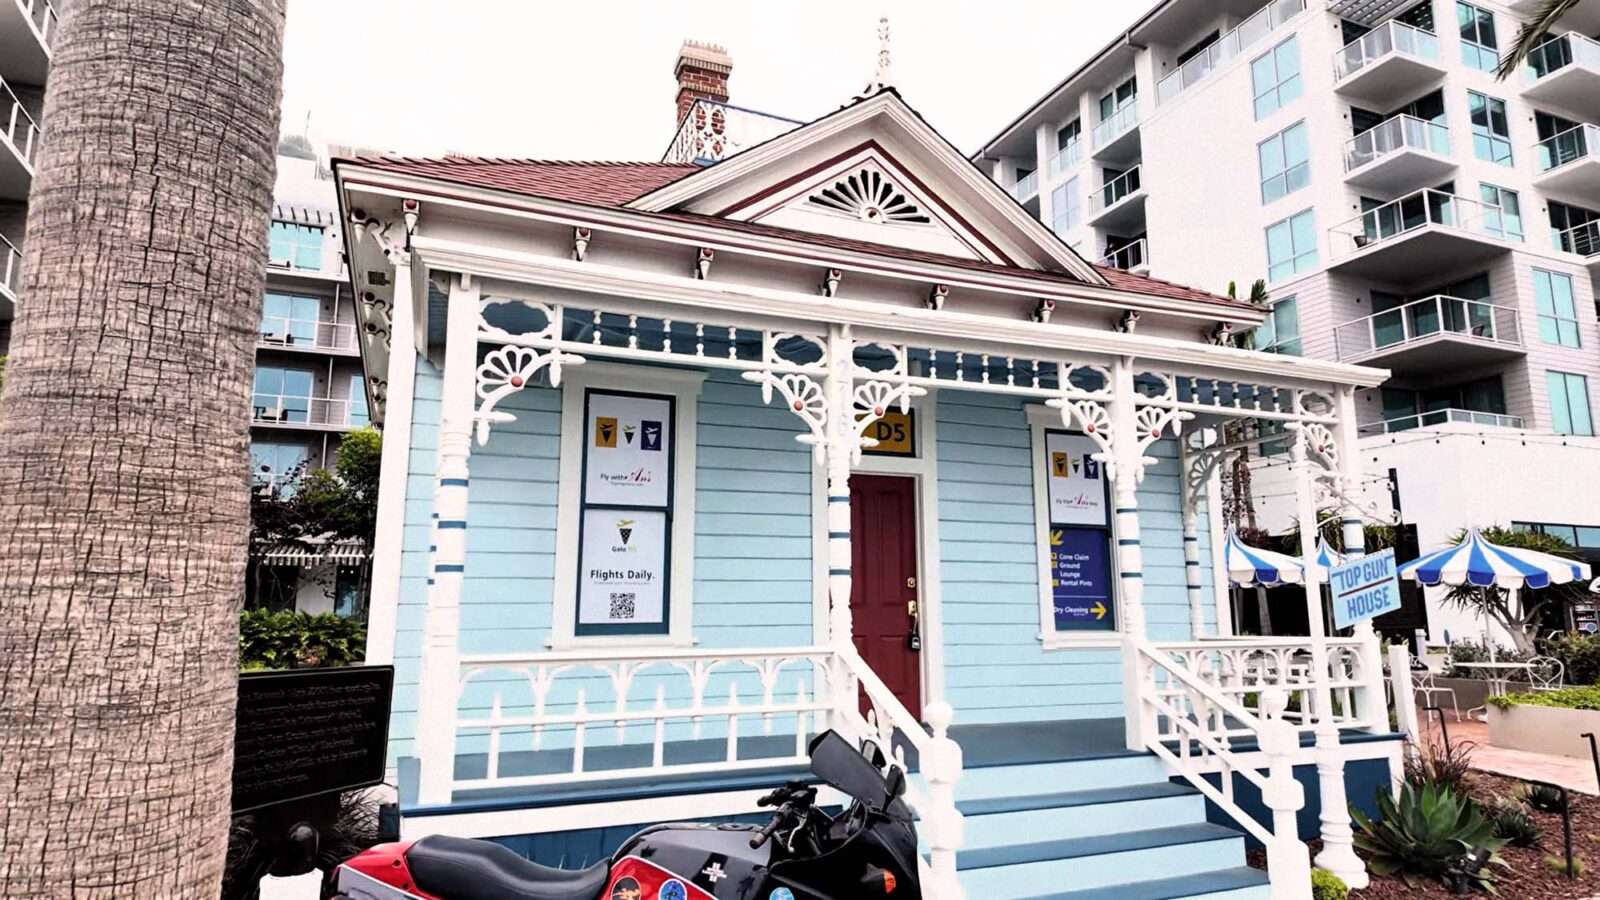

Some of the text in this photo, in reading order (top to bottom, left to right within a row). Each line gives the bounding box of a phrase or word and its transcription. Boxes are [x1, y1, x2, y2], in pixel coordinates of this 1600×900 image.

[877, 421, 905, 442] D5
[1074, 553, 1090, 561] Claim
[590, 569, 655, 581] Flights Daily.
[1060, 571, 1081, 579] Lounge
[1331, 554, 1394, 590] TOP GUN
[1347, 586, 1391, 619] HOUSE
[1054, 606, 1063, 614] Dry
[1064, 606, 1089, 615] Cleaning
